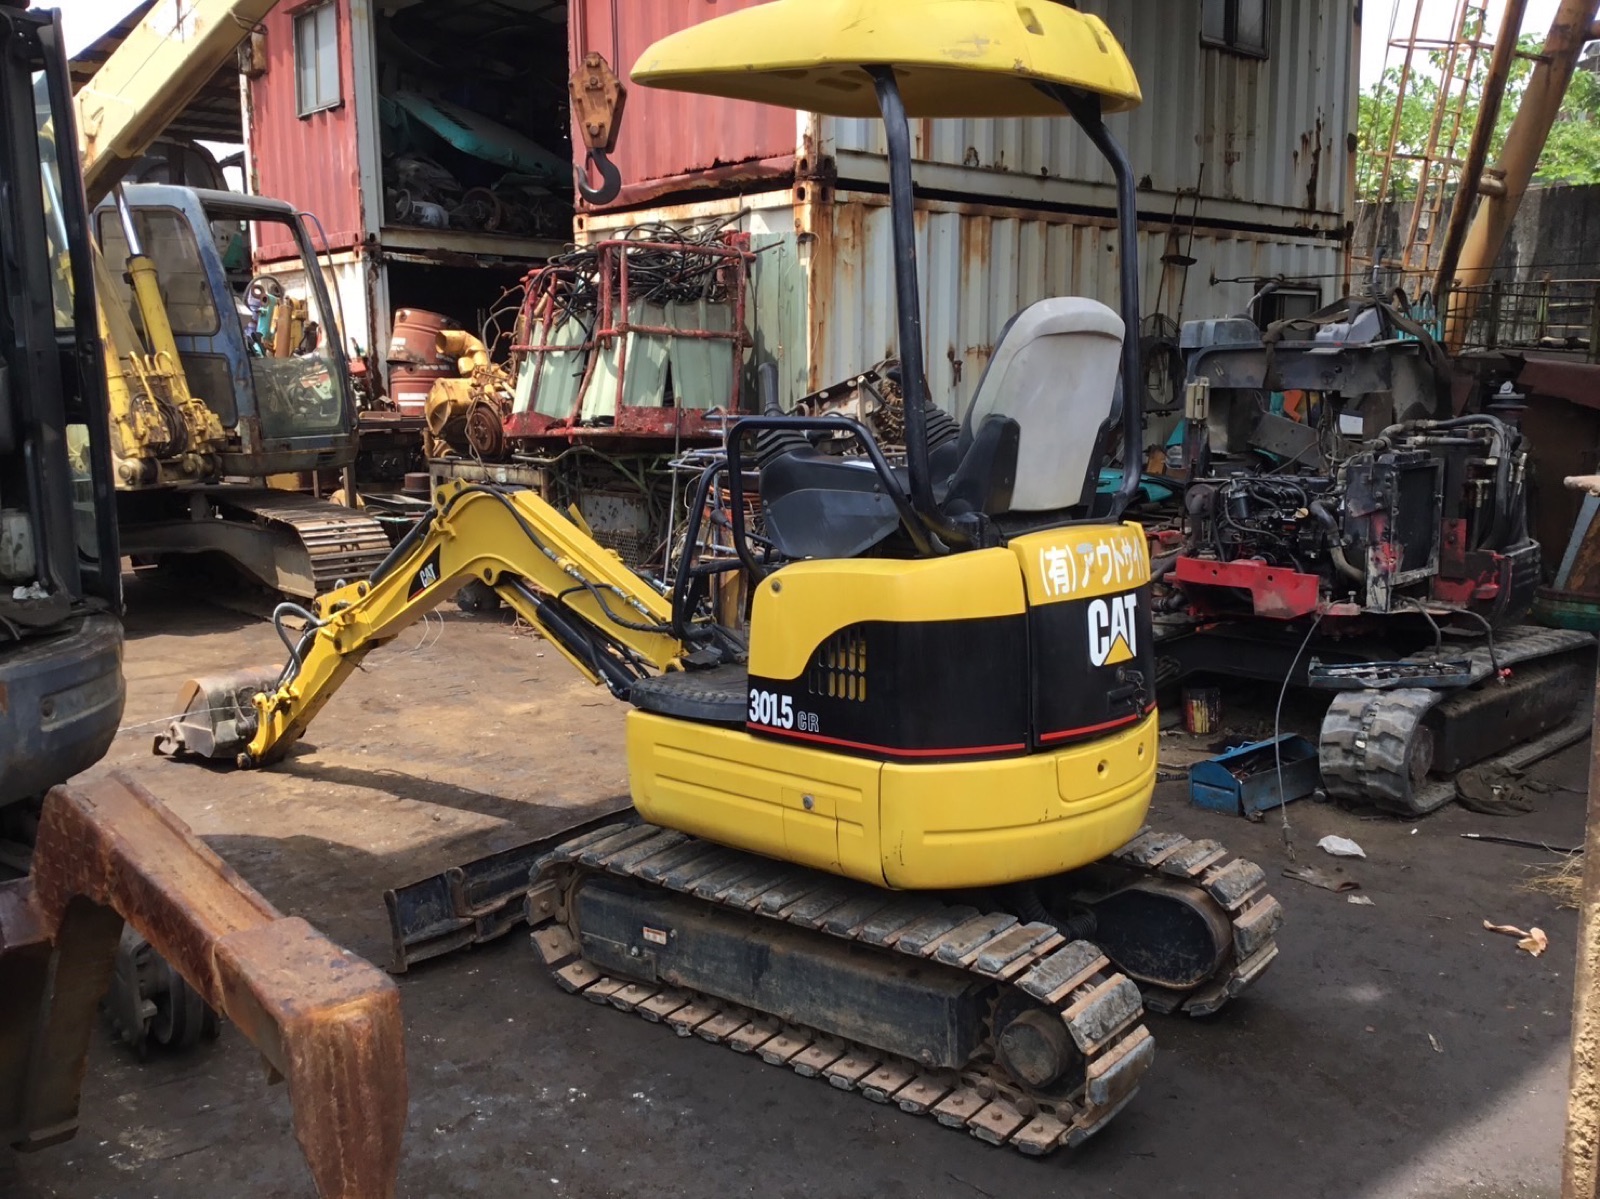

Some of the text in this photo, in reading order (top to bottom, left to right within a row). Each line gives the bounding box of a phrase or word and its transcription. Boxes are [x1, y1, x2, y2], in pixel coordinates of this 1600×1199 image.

[420, 563, 437, 588] CAT
[1087, 593, 1137, 667] CAT
[748, 688, 819, 732] 301.5 CR
